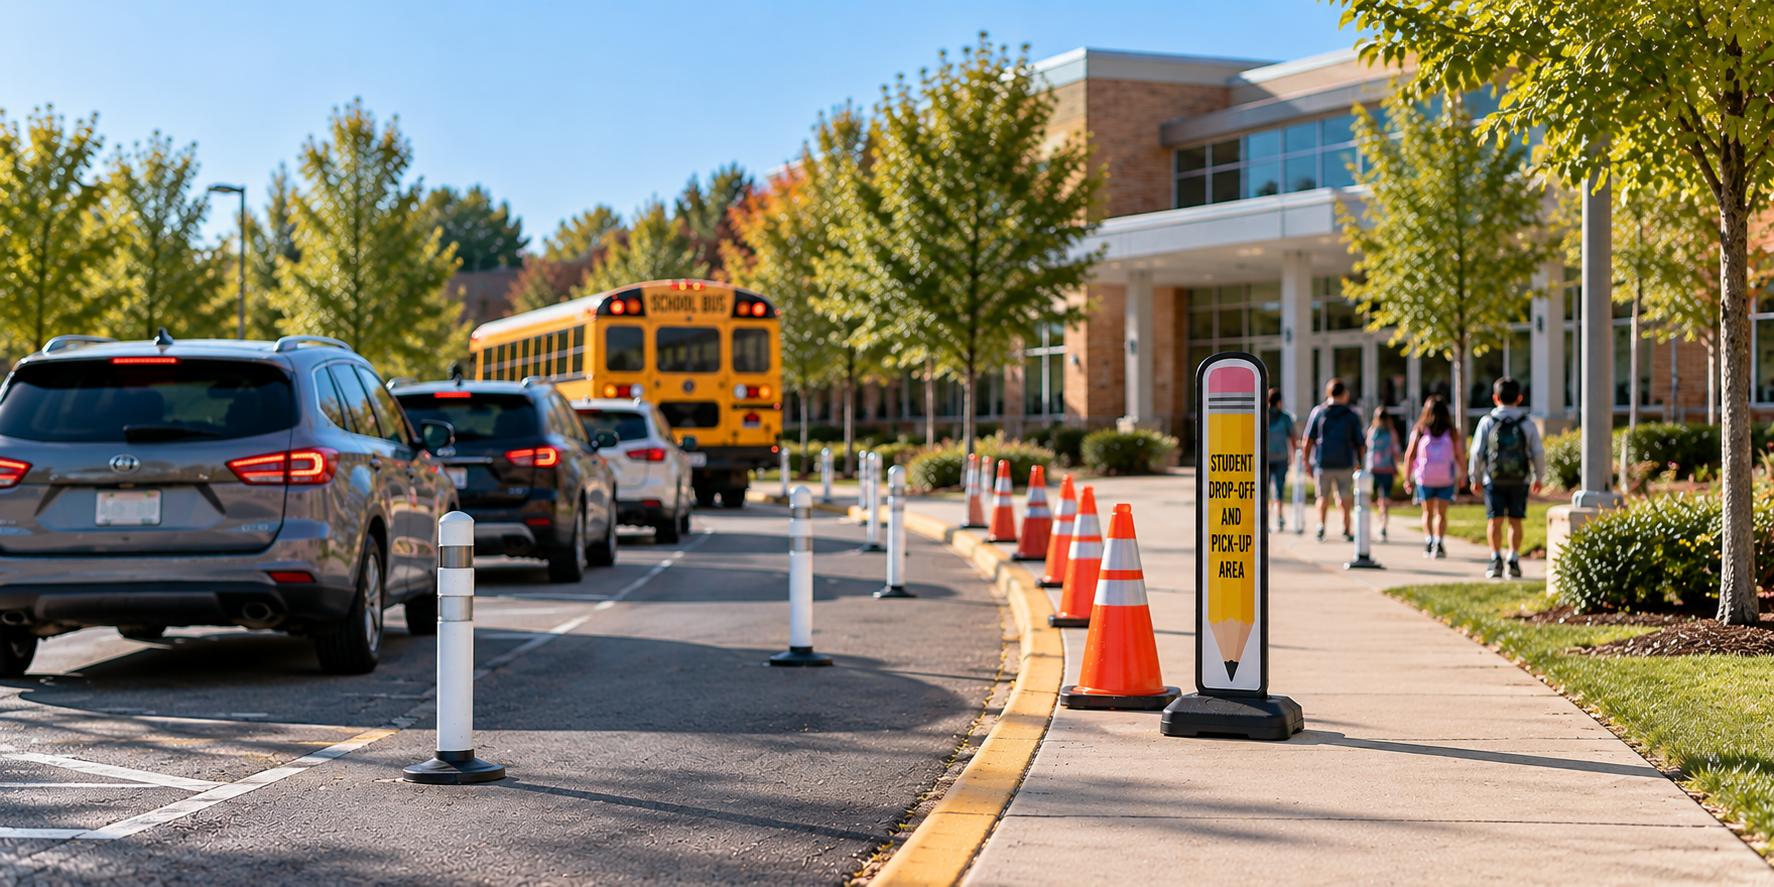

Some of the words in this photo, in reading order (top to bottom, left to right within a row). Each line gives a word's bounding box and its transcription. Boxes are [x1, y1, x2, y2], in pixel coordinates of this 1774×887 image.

[650, 294, 697, 313] SCHOOL
[702, 295, 727, 313] BUS
[1211, 454, 1253, 472] STUDENT
[1209, 481, 1255, 499] DROP-OFF
[1221, 507, 1241, 525] AND
[1211, 534, 1252, 552] PICK-UP
[1218, 561, 1245, 578] AREA
